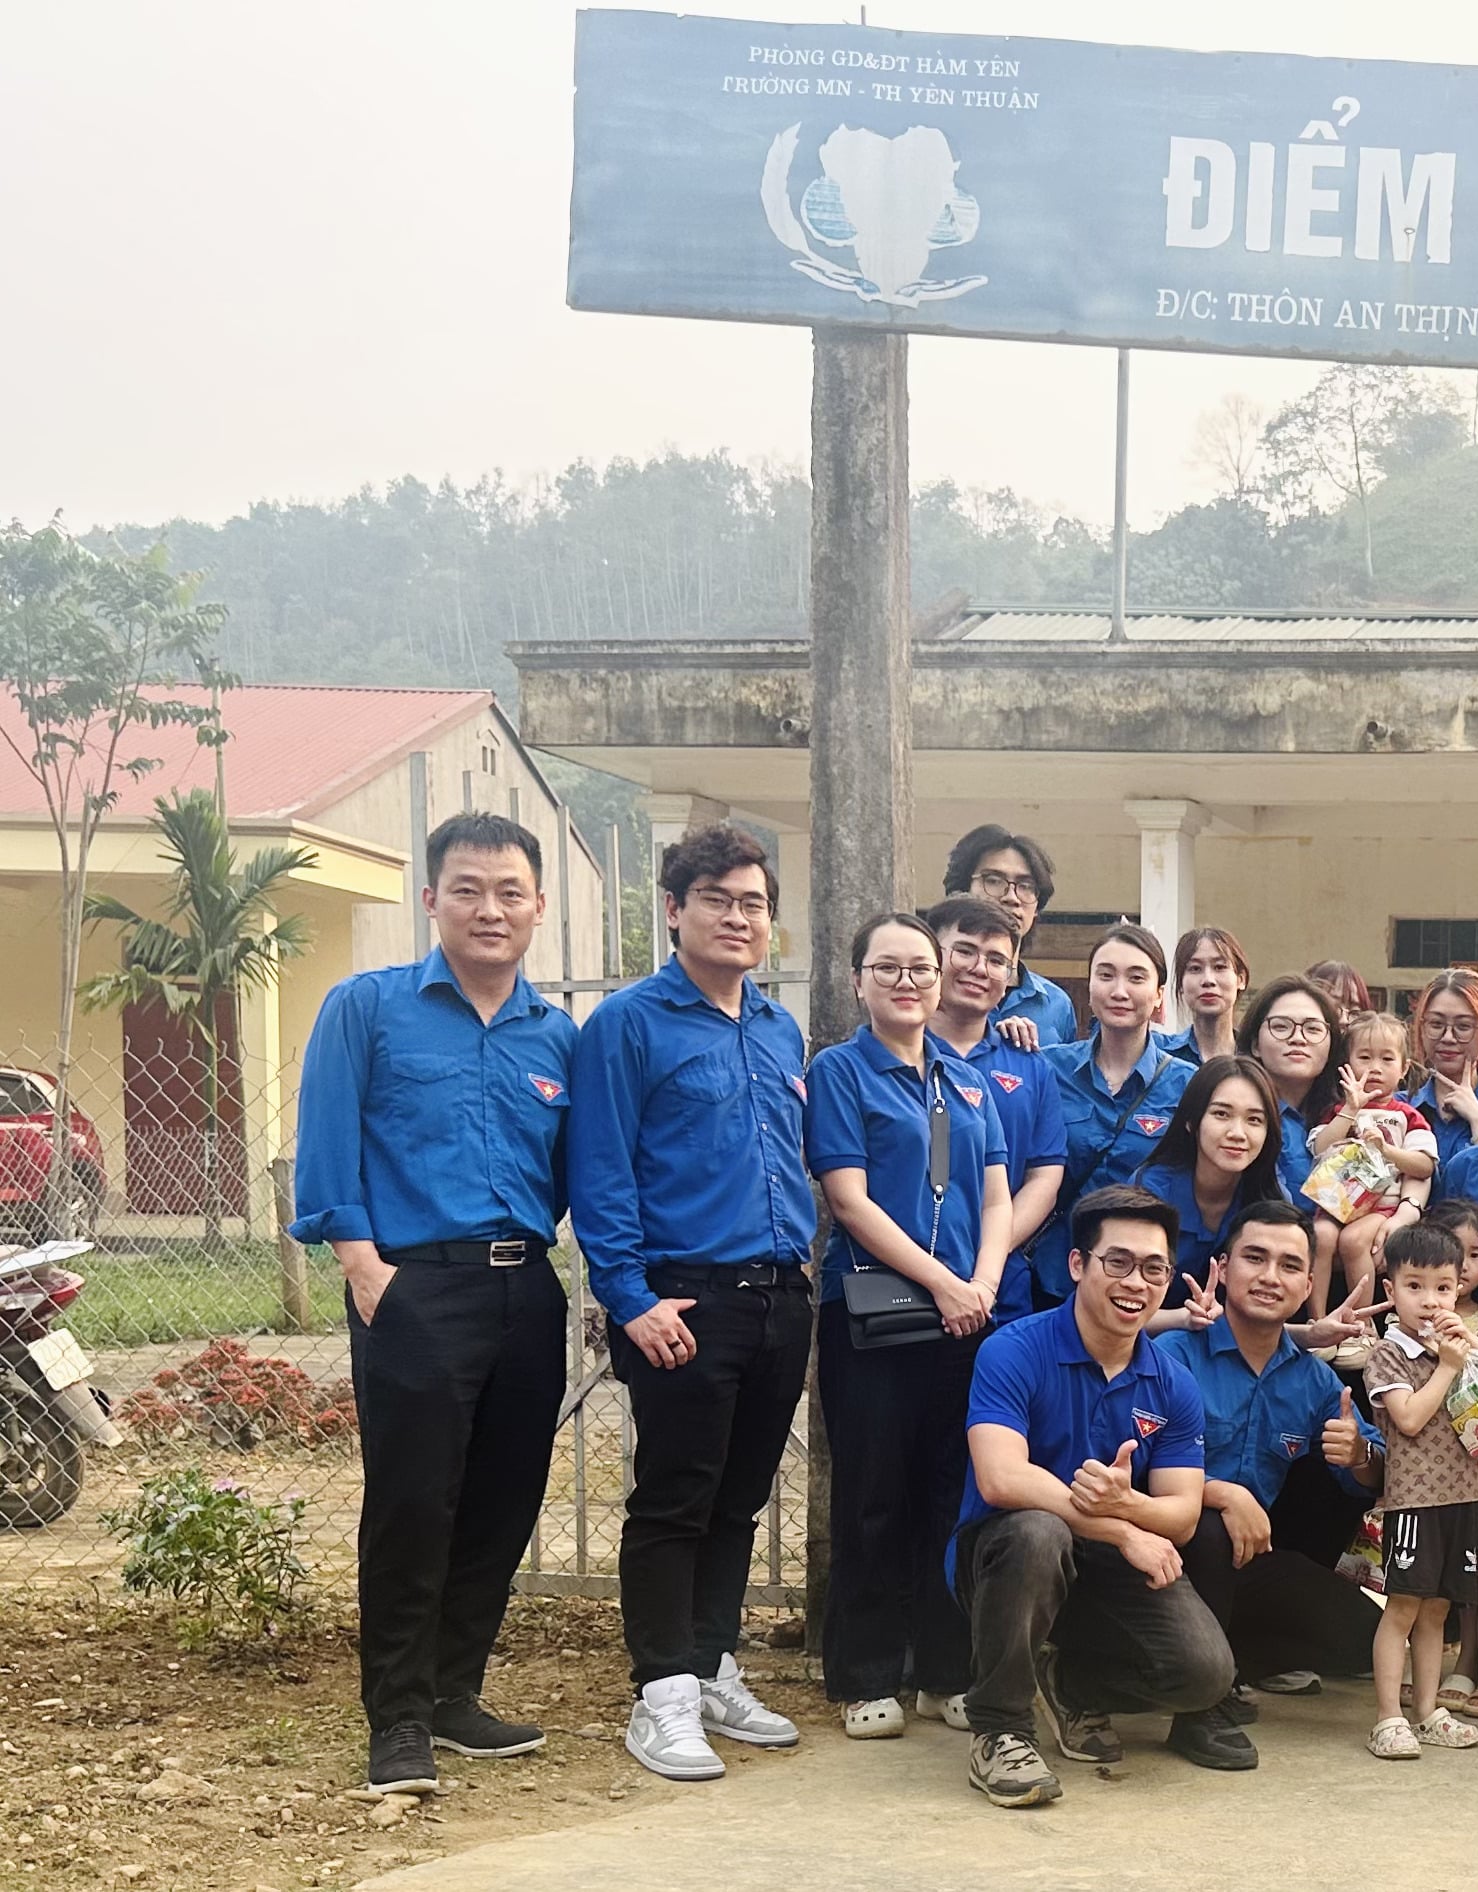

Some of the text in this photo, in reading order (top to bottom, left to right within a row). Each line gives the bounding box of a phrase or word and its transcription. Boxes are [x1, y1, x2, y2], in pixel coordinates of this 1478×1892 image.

[748, 43, 1021, 78] PHÒNG GD&ĐT HÀM YÊN
[721, 71, 810, 95] TRƯỜNG
[815, 78, 853, 97] MN
[871, 82, 902, 102] TH
[961, 86, 1041, 115] THUẬN
[1162, 95, 1457, 264] ĐIỂM
[1155, 288, 1218, 320] Đ/C:
[1227, 287, 1324, 327] THÔN
[1333, 299, 1385, 330] AN
